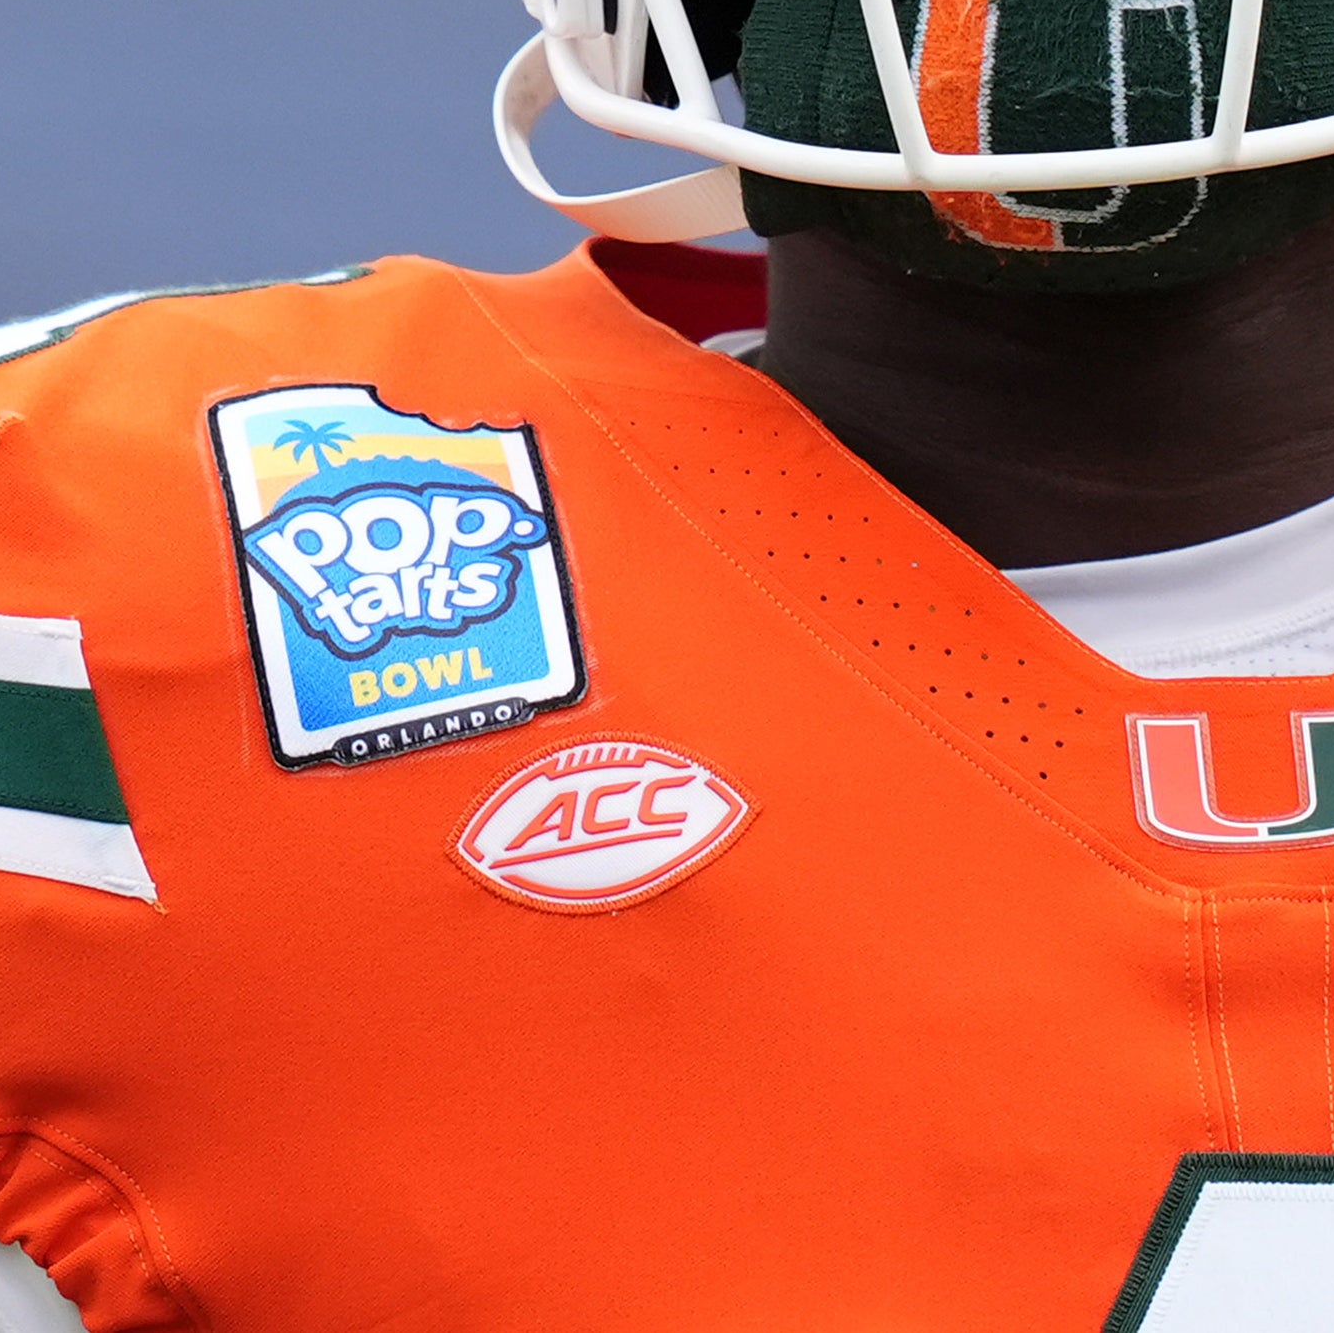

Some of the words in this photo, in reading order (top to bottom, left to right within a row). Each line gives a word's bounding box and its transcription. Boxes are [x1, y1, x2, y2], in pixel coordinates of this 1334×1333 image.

[349, 646, 494, 708] BOWL
[350, 704, 514, 757] ORLANDO
[504, 774, 698, 852] ACC
